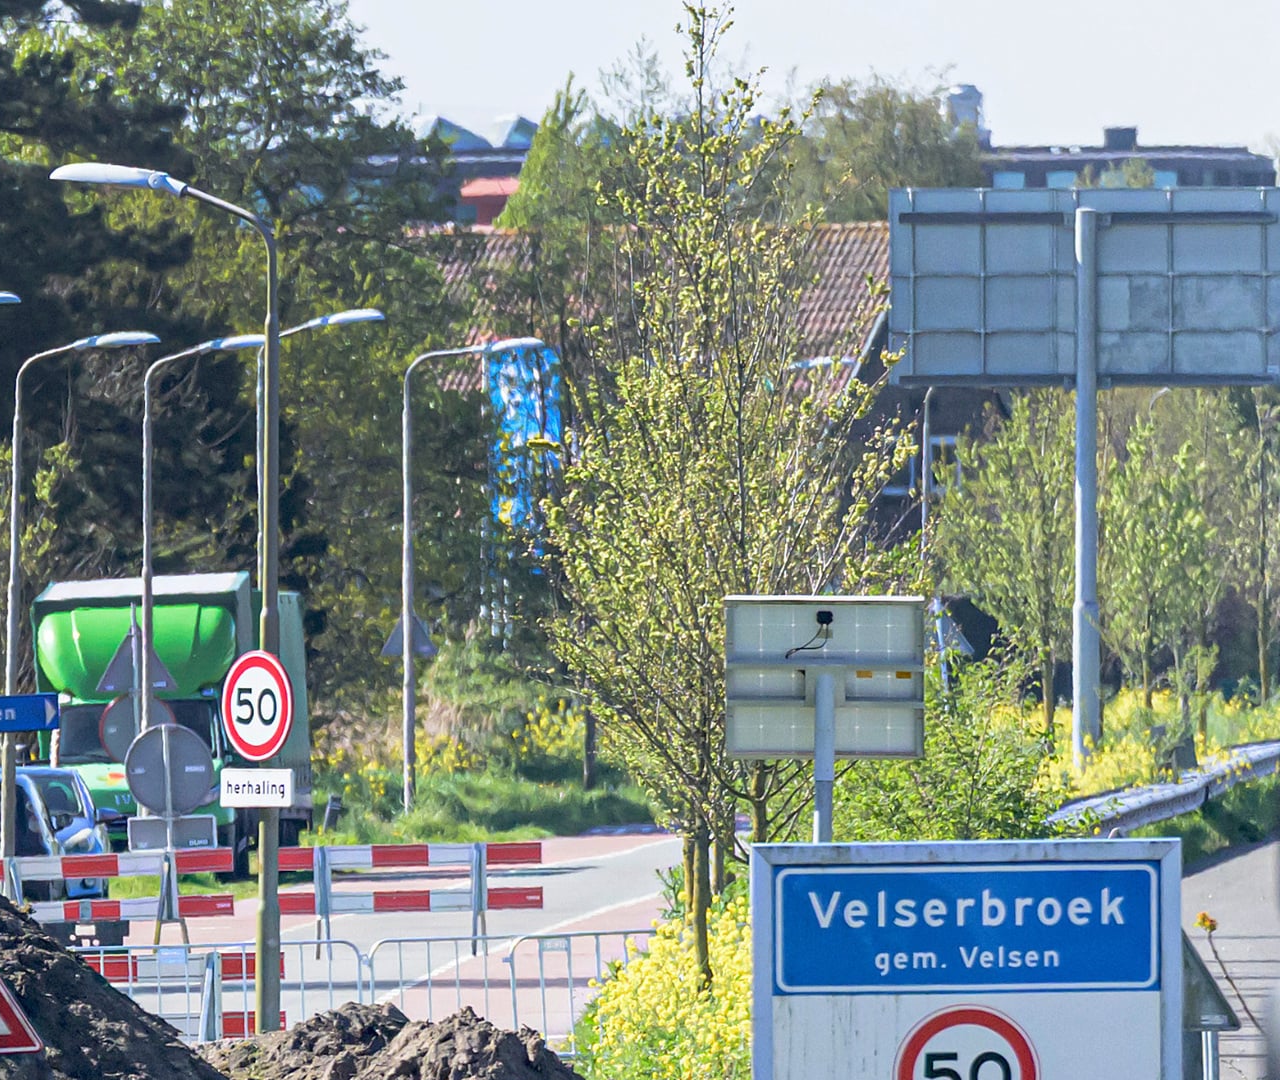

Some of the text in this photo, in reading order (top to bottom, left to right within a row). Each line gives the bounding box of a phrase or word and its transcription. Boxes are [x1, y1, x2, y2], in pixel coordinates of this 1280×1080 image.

[236, 687, 277, 726] 50
[226, 780, 285, 799] herhaling
[808, 887, 1125, 929] Velserbroek
[874, 946, 1060, 977] gem. Velsen
